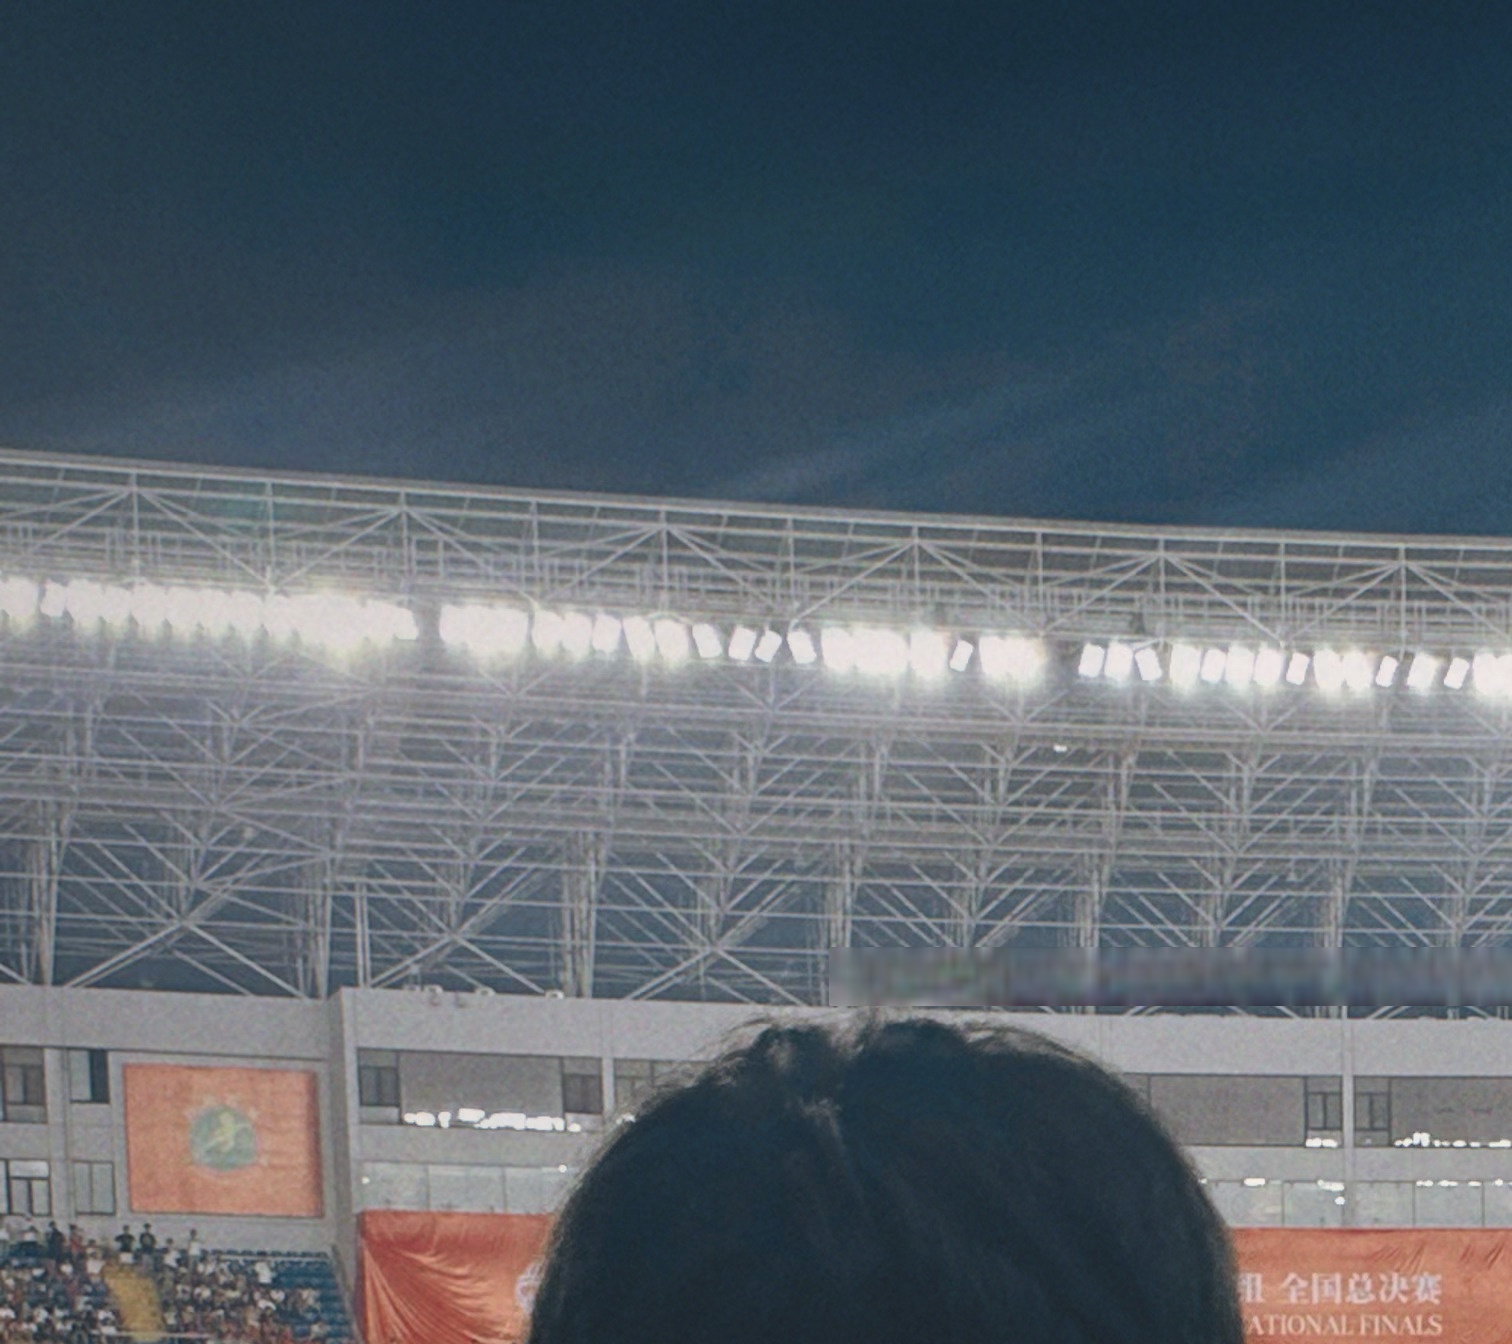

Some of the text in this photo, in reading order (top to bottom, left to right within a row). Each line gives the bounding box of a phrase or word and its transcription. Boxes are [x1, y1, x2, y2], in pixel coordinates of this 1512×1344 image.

[1281, 1272, 1442, 1304] 全国总决赛
[1248, 1314, 1444, 1335] ATIONAL FINALS
